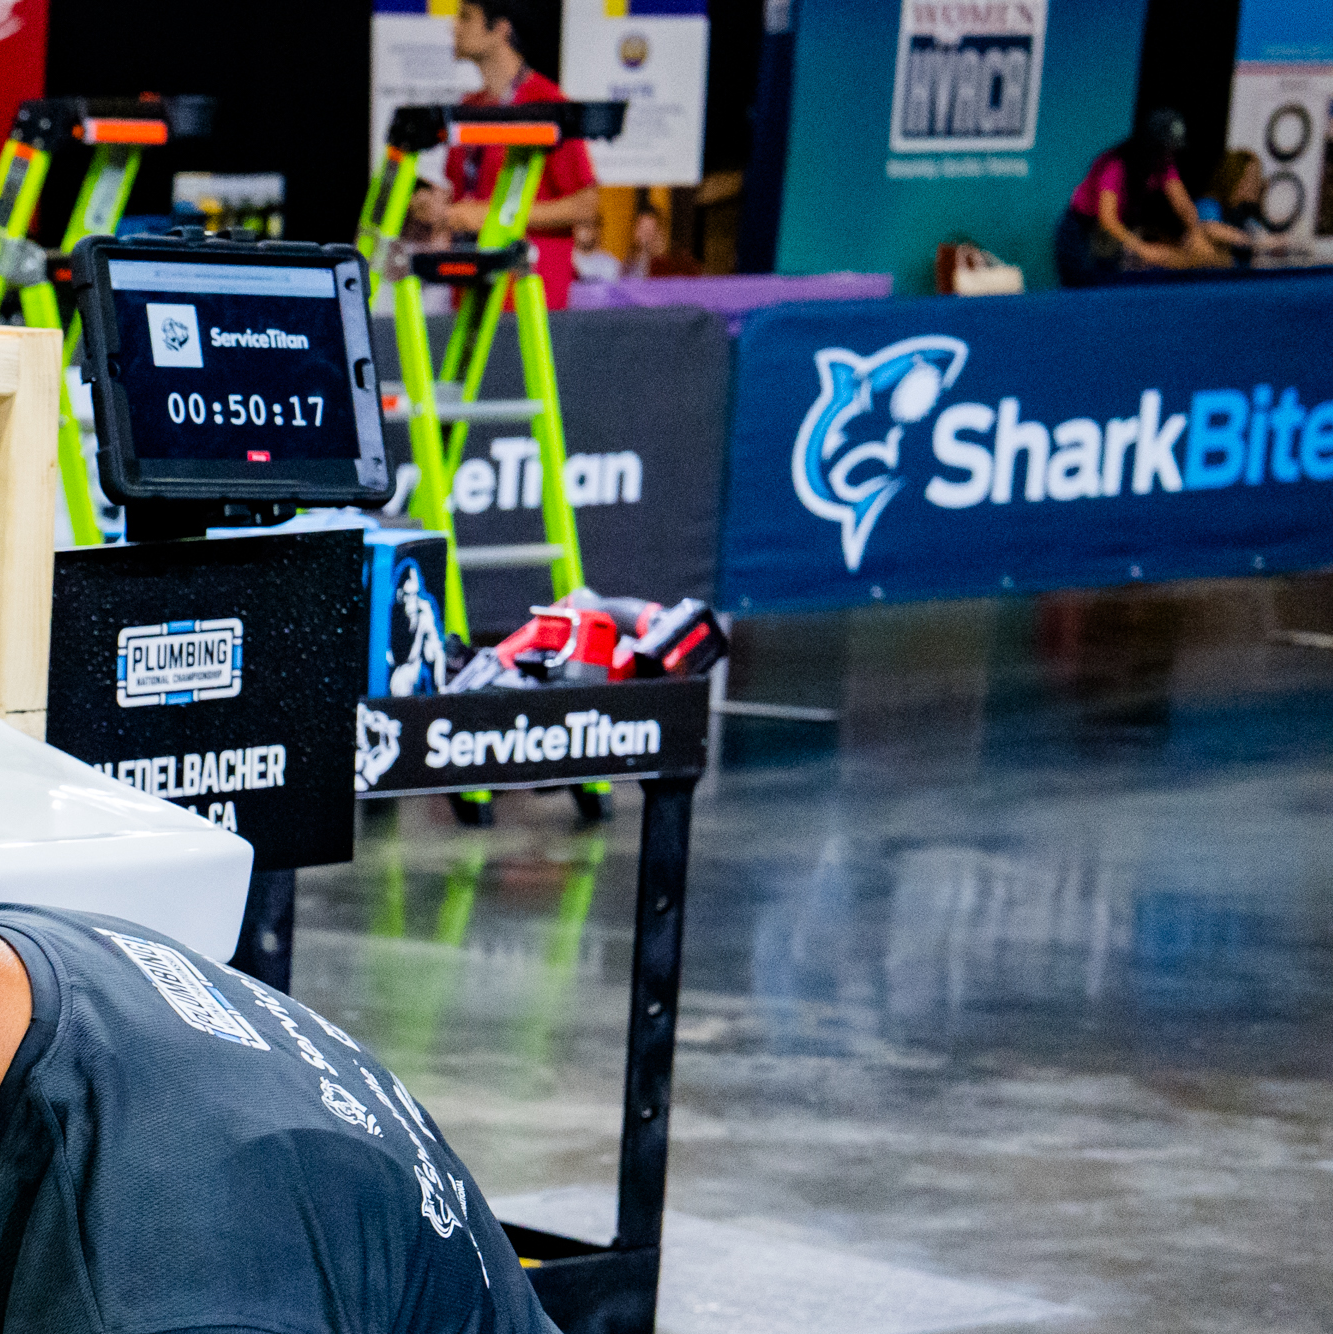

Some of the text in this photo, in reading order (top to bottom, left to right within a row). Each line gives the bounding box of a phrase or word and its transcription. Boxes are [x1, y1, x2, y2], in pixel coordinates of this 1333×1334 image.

[210, 327, 309, 350] ServiceTitan
[167, 392, 324, 427] 00:50:17
[925, 383, 1333, 511] SharkBite
[132, 639, 227, 673] PLUMBING
[425, 708, 661, 768] ServiceTitan
